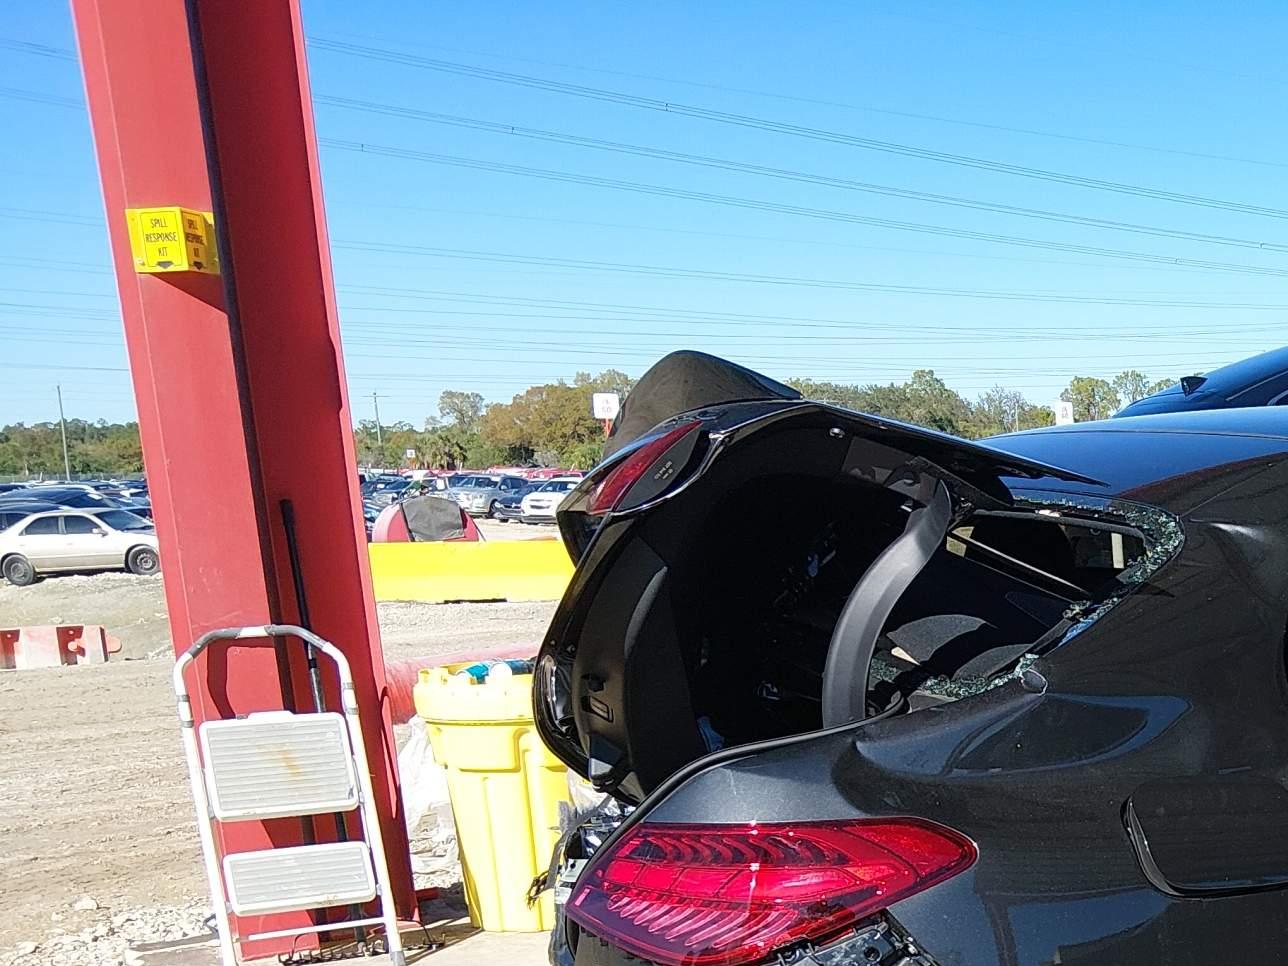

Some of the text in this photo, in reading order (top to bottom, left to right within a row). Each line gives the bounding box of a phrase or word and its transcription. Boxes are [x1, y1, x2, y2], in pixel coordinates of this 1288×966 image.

[151, 216, 168, 228] SPILL
[145, 232, 177, 243] RESPONSE
[158, 247, 168, 257] KIT
